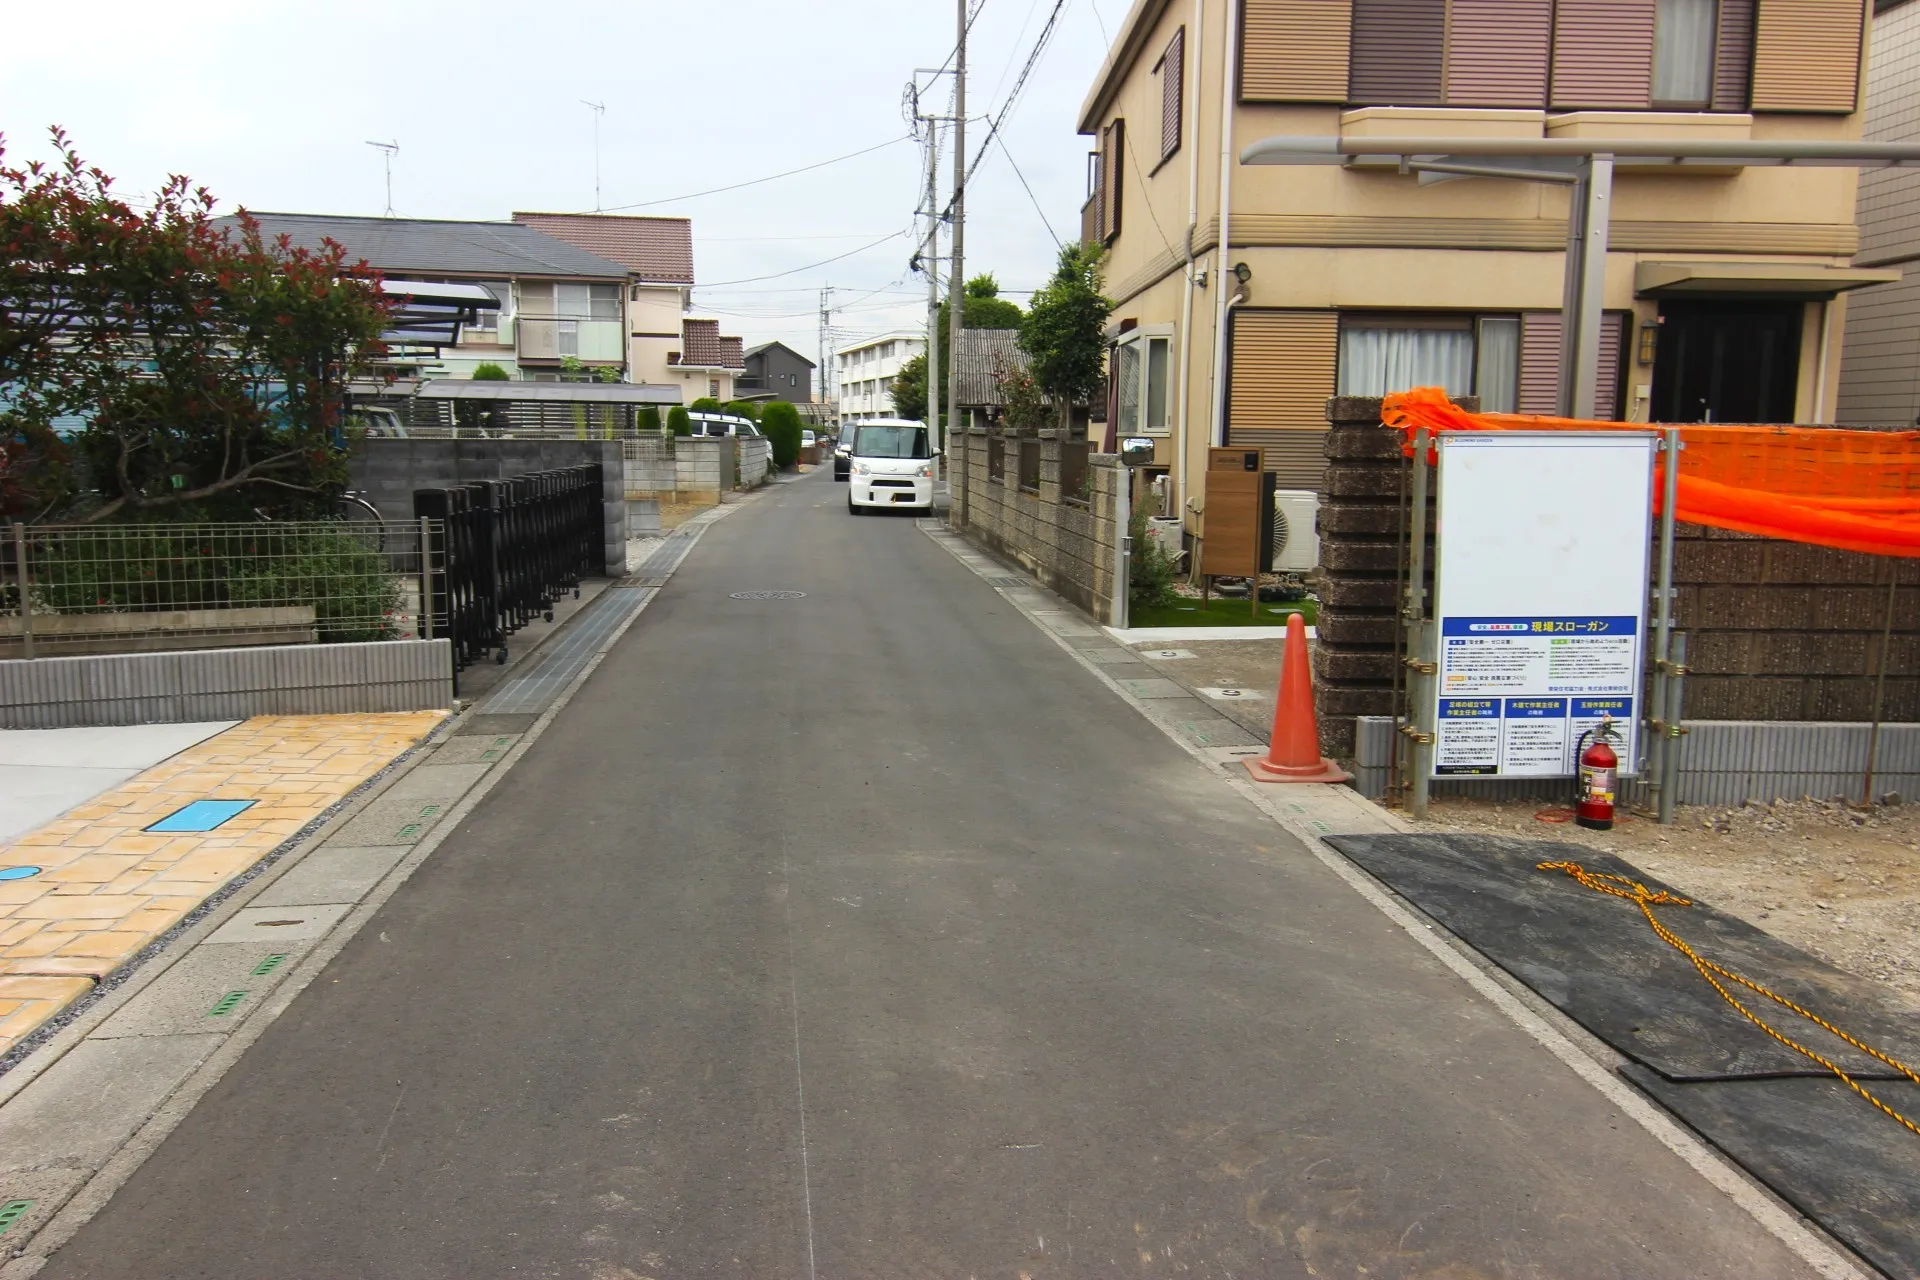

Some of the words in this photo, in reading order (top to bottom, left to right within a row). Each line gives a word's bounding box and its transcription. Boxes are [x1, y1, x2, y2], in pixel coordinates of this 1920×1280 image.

[1531, 621, 1609, 632] 現場スローガン
